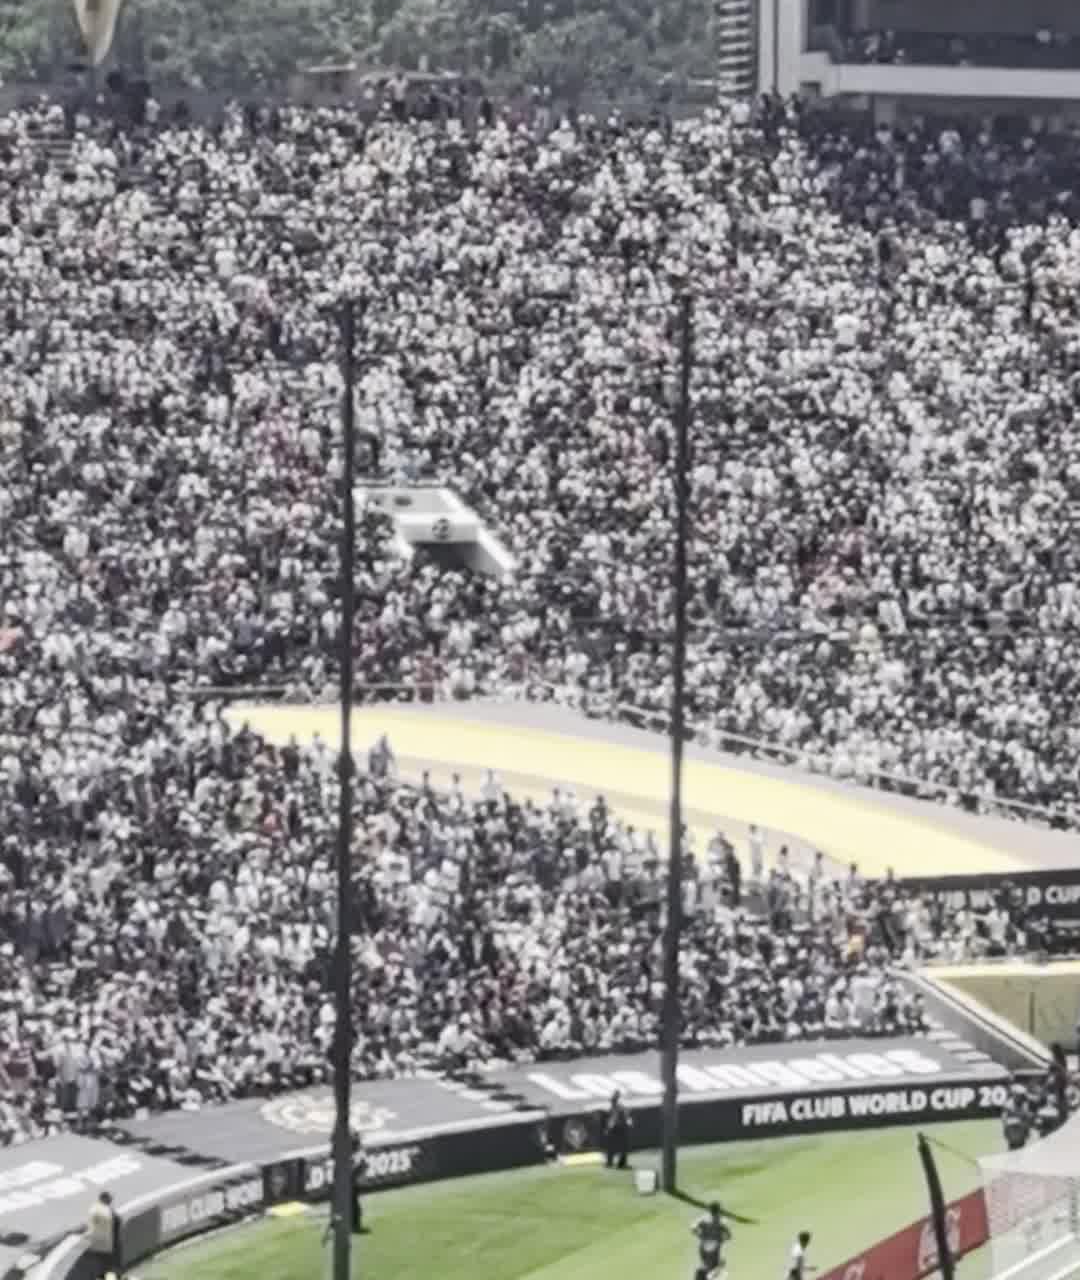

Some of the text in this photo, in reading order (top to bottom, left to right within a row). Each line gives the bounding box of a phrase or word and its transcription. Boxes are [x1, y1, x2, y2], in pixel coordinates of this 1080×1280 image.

[742, 1103, 789, 1127] FIFA
[790, 1096, 846, 1120] CLUB
[850, 1088, 928, 1116] WORLD
[930, 1087, 976, 1110] CUP
